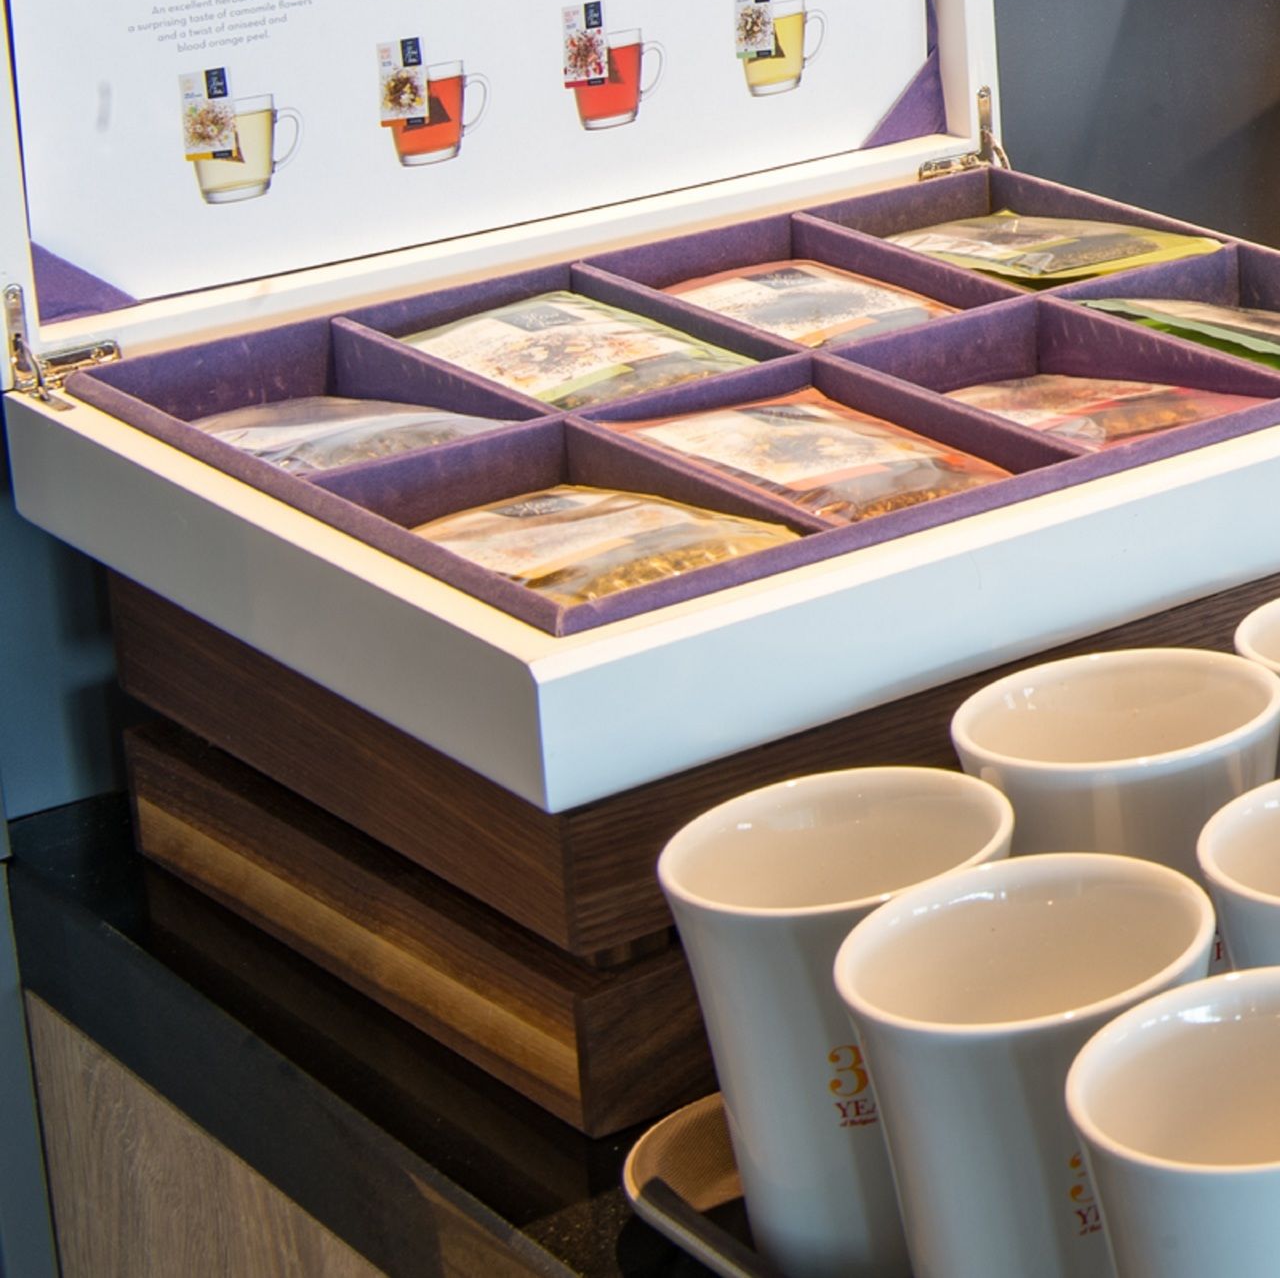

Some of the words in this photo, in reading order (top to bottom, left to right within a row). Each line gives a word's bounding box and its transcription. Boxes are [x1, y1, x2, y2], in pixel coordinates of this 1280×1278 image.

[137, 17, 187, 31] surprising
[189, 13, 214, 23] taste
[216, 11, 227, 19] of
[229, 3, 276, 17] camomile
[152, 6, 166, 14] An
[168, 0, 213, 12] excellent
[157, 31, 177, 42] and
[189, 26, 213, 37] twist
[215, 24, 226, 34] of
[227, 18, 266, 31] aniseed
[268, 14, 288, 24] and
[177, 41, 206, 52] blood
[209, 35, 244, 48] orange
[828, 1045, 869, 1097] 3
